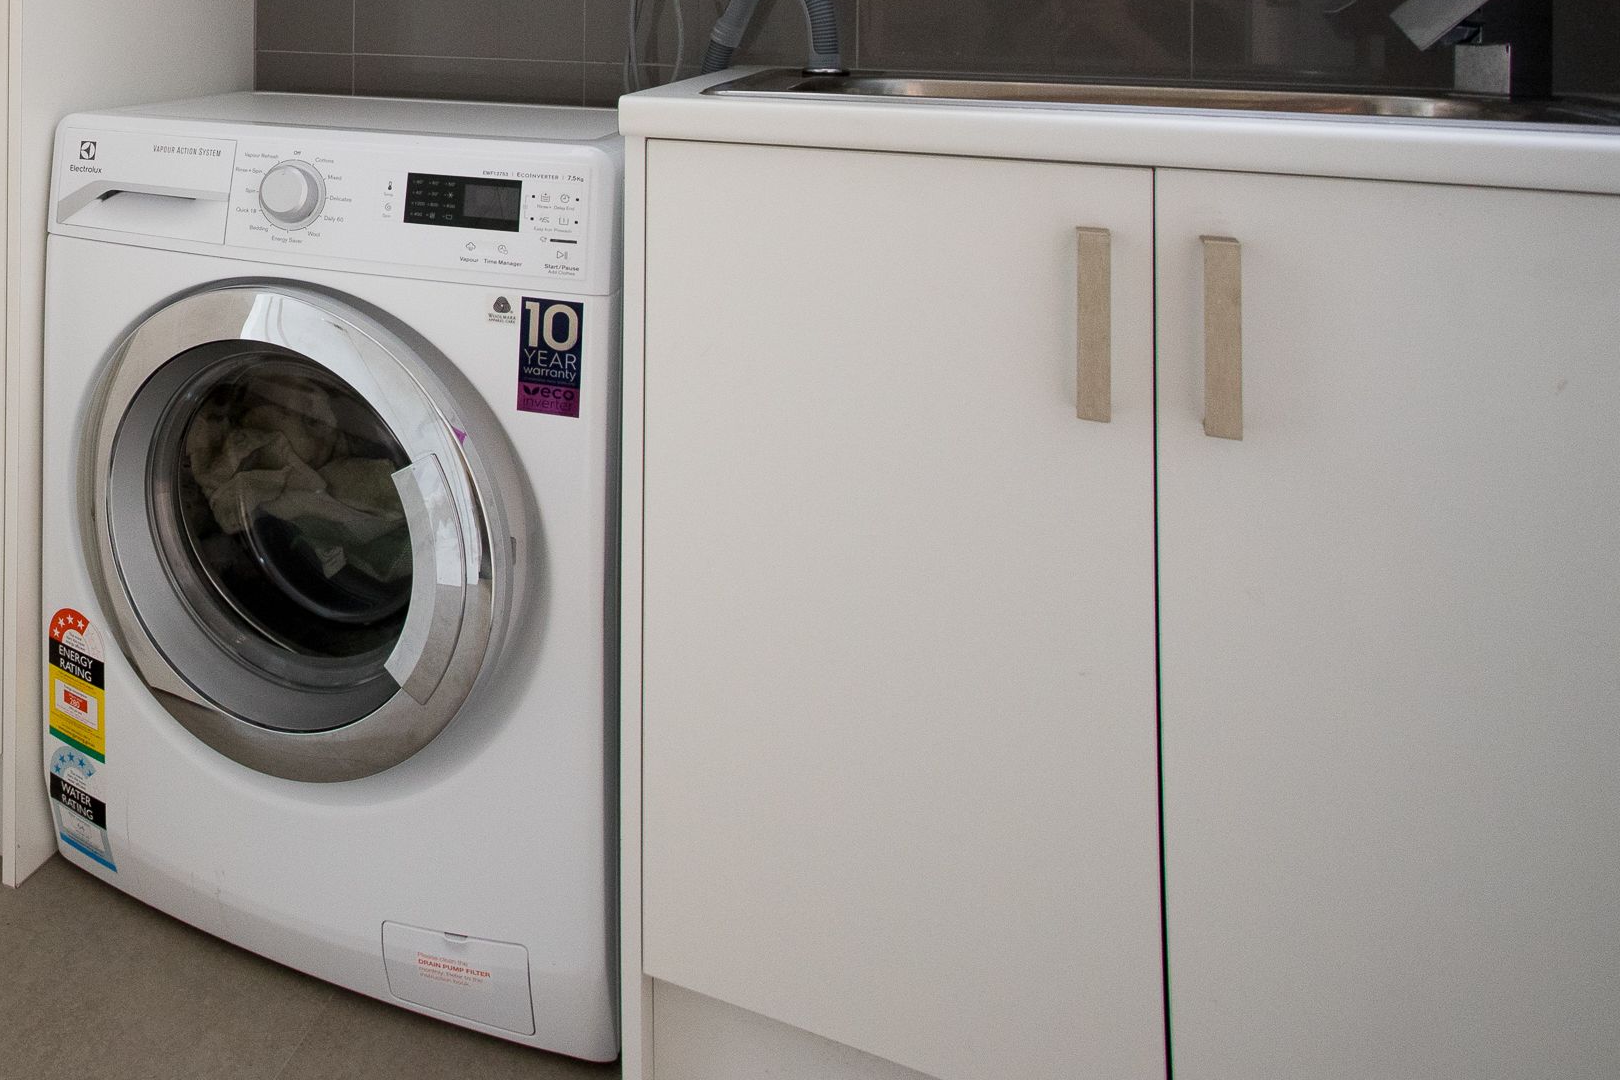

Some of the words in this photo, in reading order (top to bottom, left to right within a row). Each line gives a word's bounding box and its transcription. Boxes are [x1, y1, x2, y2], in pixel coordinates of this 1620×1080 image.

[69, 163, 103, 174] Electrolux
[525, 300, 579, 352] 10
[524, 348, 577, 370] YEAR
[523, 366, 577, 382] warranty
[540, 386, 575, 401] eco
[523, 398, 572, 412] inverter
[59, 644, 94, 669] ENERGY
[59, 657, 92, 682] RATING
[60, 780, 92, 808] WATER
[61, 793, 94, 820] RATING
[418, 958, 441, 968] DRAIN
[442, 964, 465, 973] PUMP
[465, 968, 491, 978] FILTER
